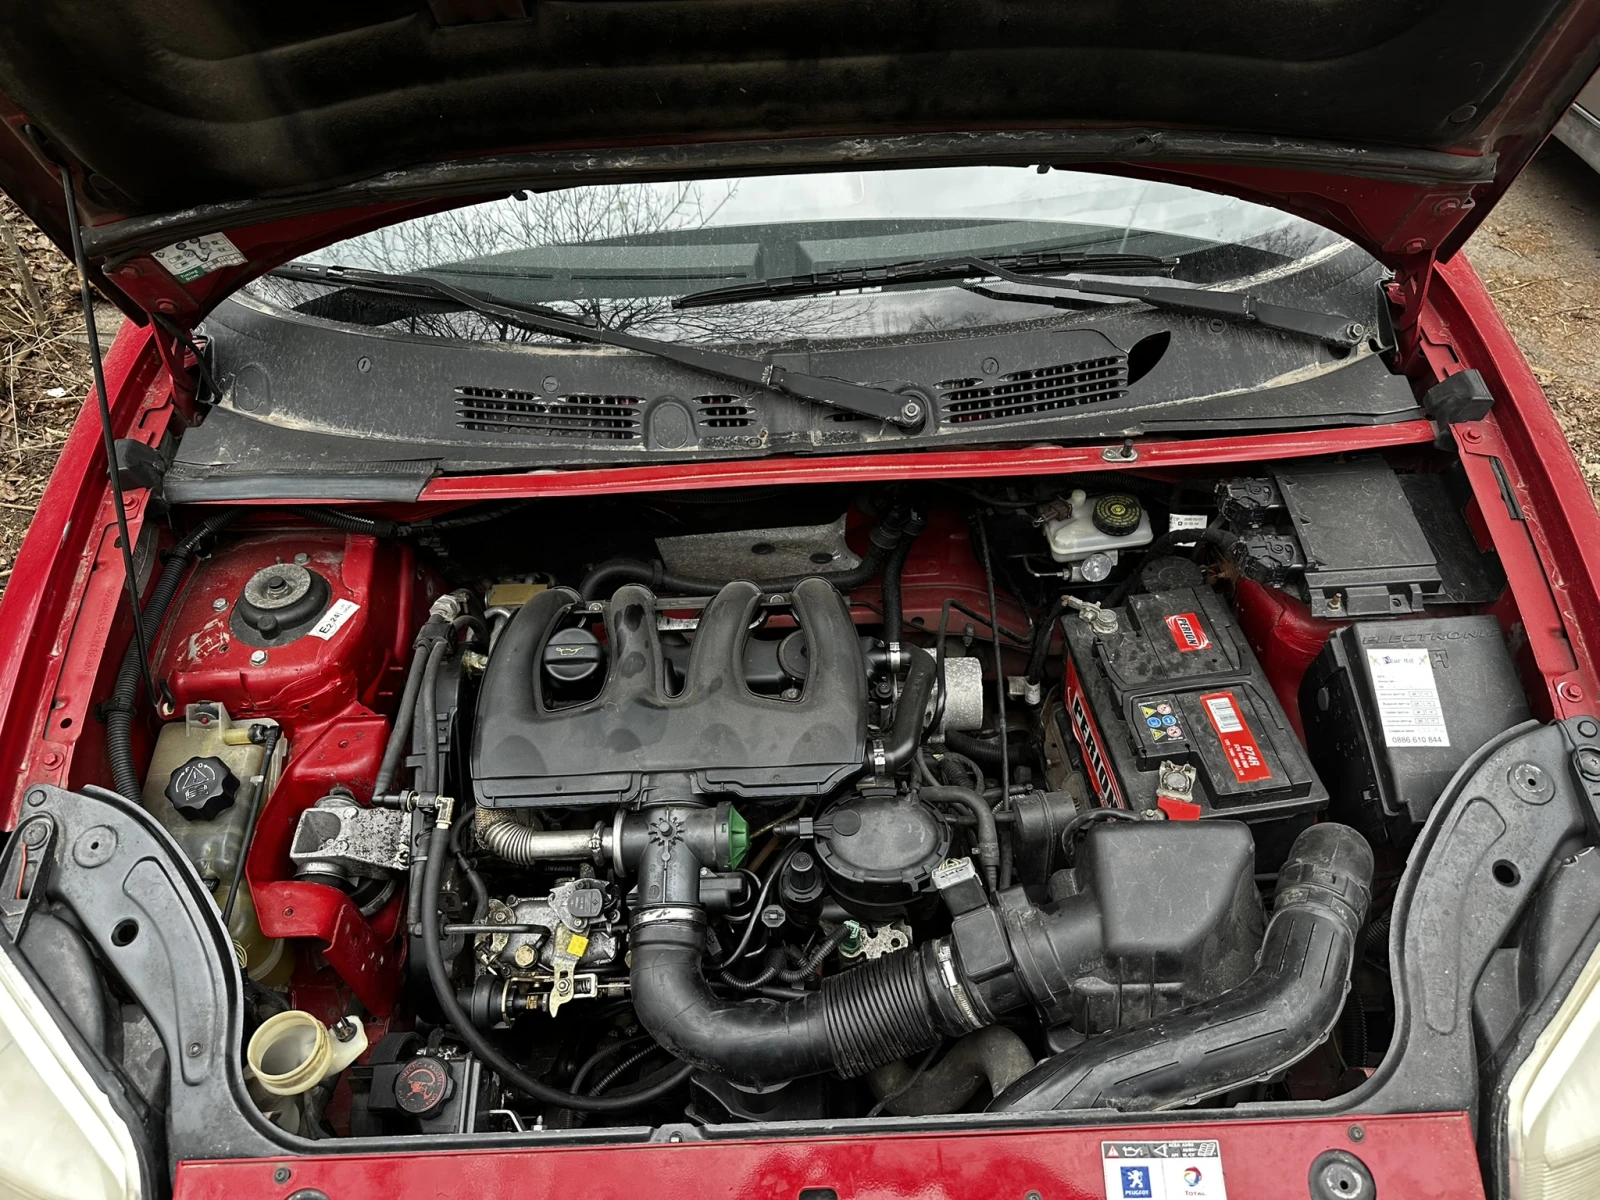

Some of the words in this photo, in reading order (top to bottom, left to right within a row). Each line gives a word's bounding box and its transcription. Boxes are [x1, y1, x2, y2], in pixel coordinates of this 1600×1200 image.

[1177, 618, 1198, 645] PERION
[1362, 629, 1500, 645] ELECTRONIC
[1241, 745, 1260, 766] P74R
